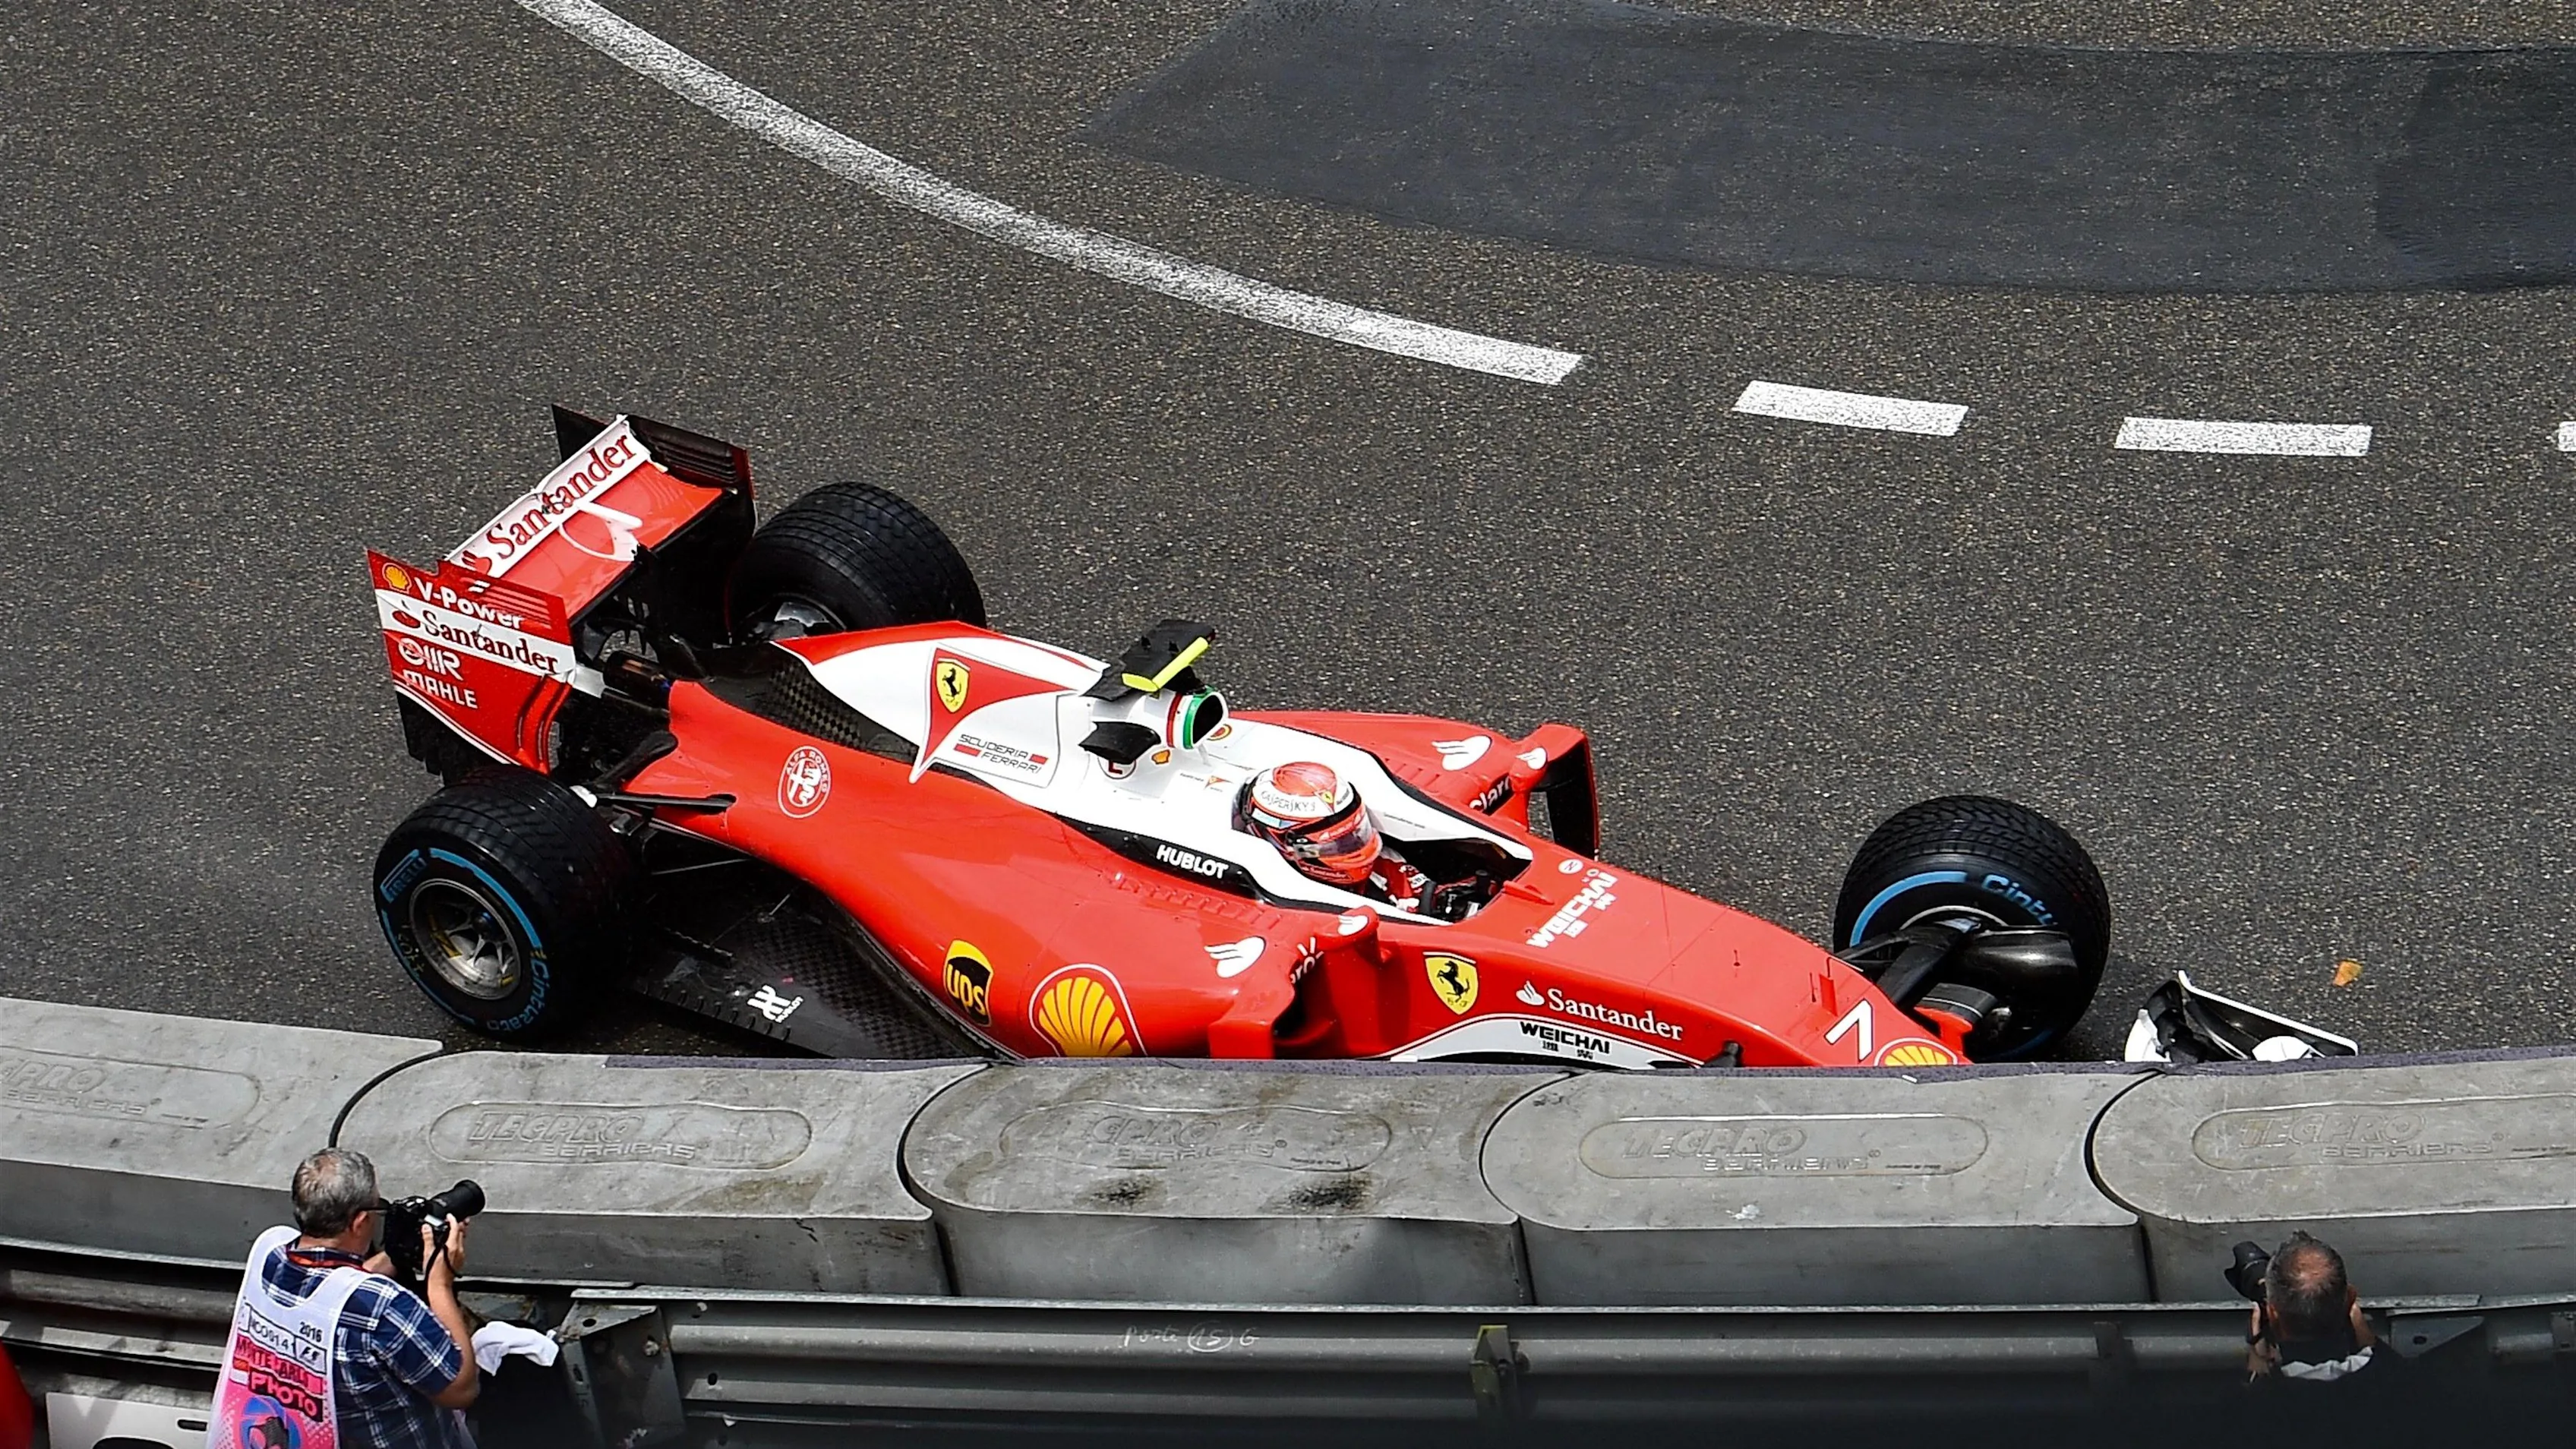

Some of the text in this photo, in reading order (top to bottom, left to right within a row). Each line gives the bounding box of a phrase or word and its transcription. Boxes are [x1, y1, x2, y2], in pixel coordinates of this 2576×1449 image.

[487, 434, 637, 560] Santander
[415, 576, 526, 630] V-Power
[422, 610, 558, 674] Santander
[402, 669, 478, 709] MAHLE
[958, 734, 1029, 759] SCUDERIA
[980, 751, 1042, 774] FERRARI
[786, 750, 829, 794] ALFA ROMEO
[1156, 844, 1230, 879] HUBLOT
[945, 961, 987, 1018] ups
[1547, 988, 1683, 1041] Santander
[1824, 999, 1873, 1062] 7
[1520, 1021, 1611, 1054] WEICHAI
[469, 1110, 644, 1143] TECPRO
[1622, 1126, 1808, 1159] TECPRO
[2237, 1112, 2428, 1149] TECPRO
[300, 1321, 322, 1343] 2016
[251, 1372, 318, 1417] PHOTO
